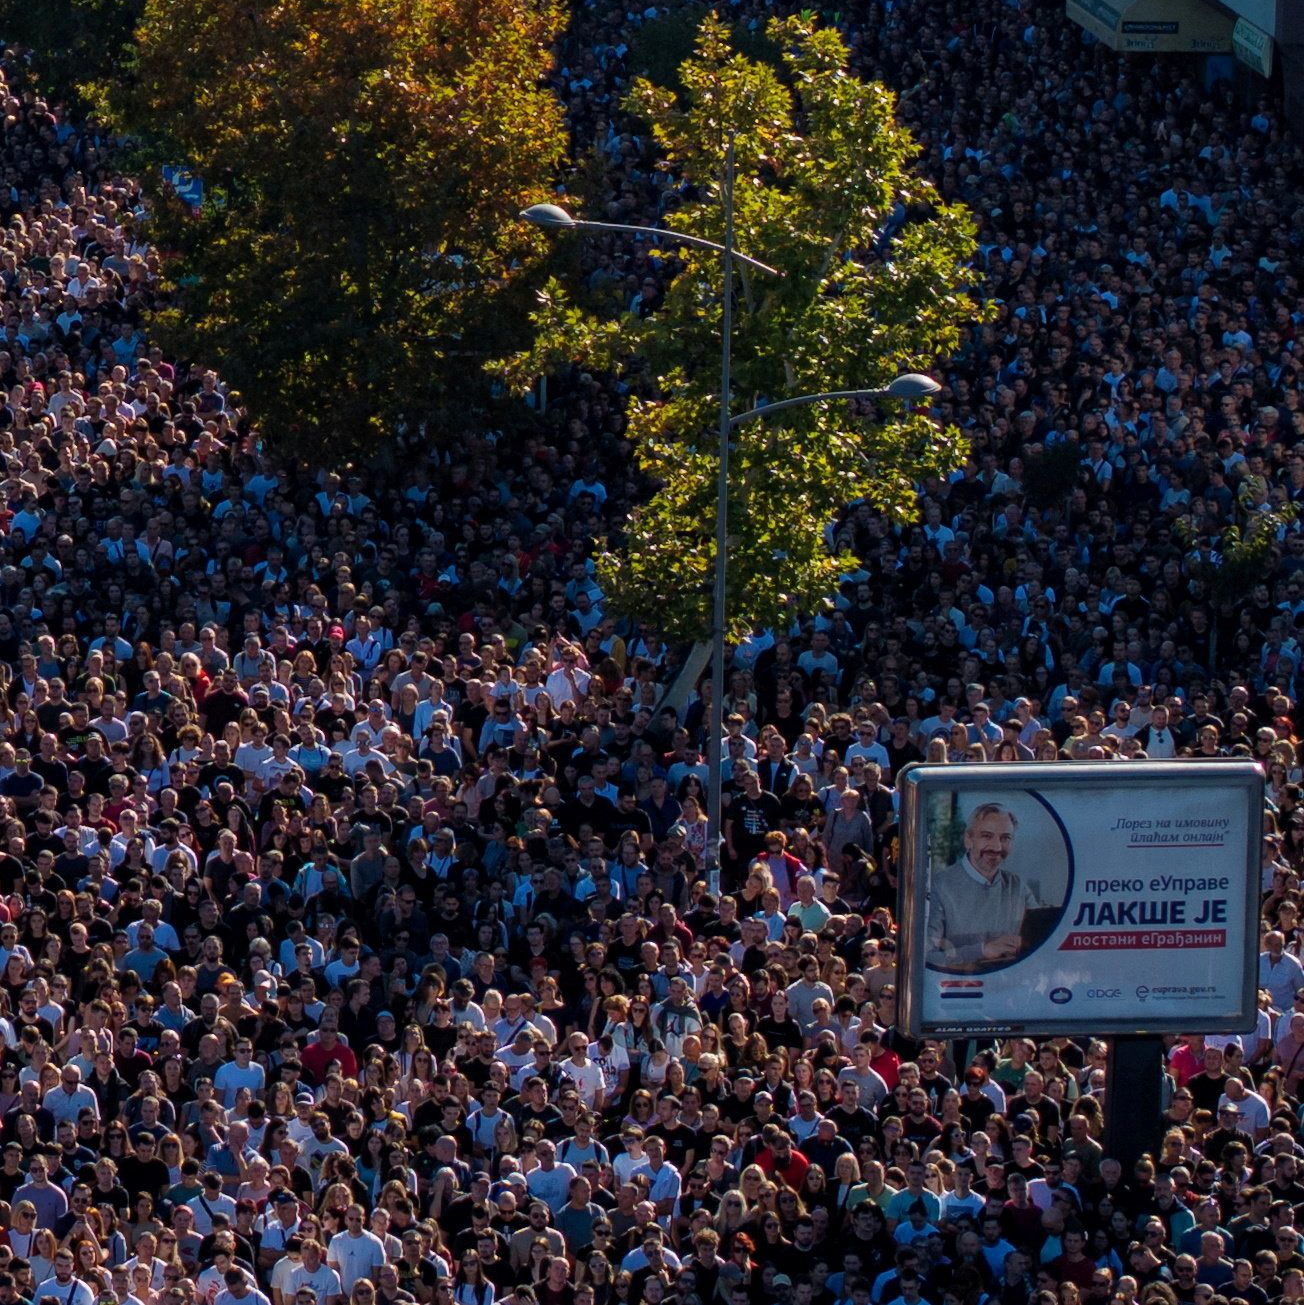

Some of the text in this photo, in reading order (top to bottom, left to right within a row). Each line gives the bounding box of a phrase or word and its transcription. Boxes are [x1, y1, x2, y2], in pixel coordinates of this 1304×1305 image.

[1155, 820, 1171, 829] на
[1175, 818, 1229, 830] имовину
[1085, 875, 1230, 896] преко еУправе
[1073, 899, 1227, 926] ЛАКШЕ ЈЕ
[1072, 932, 1223, 947] постани еГрађанин
[1152, 986, 1217, 995] euprava.gov.rs
